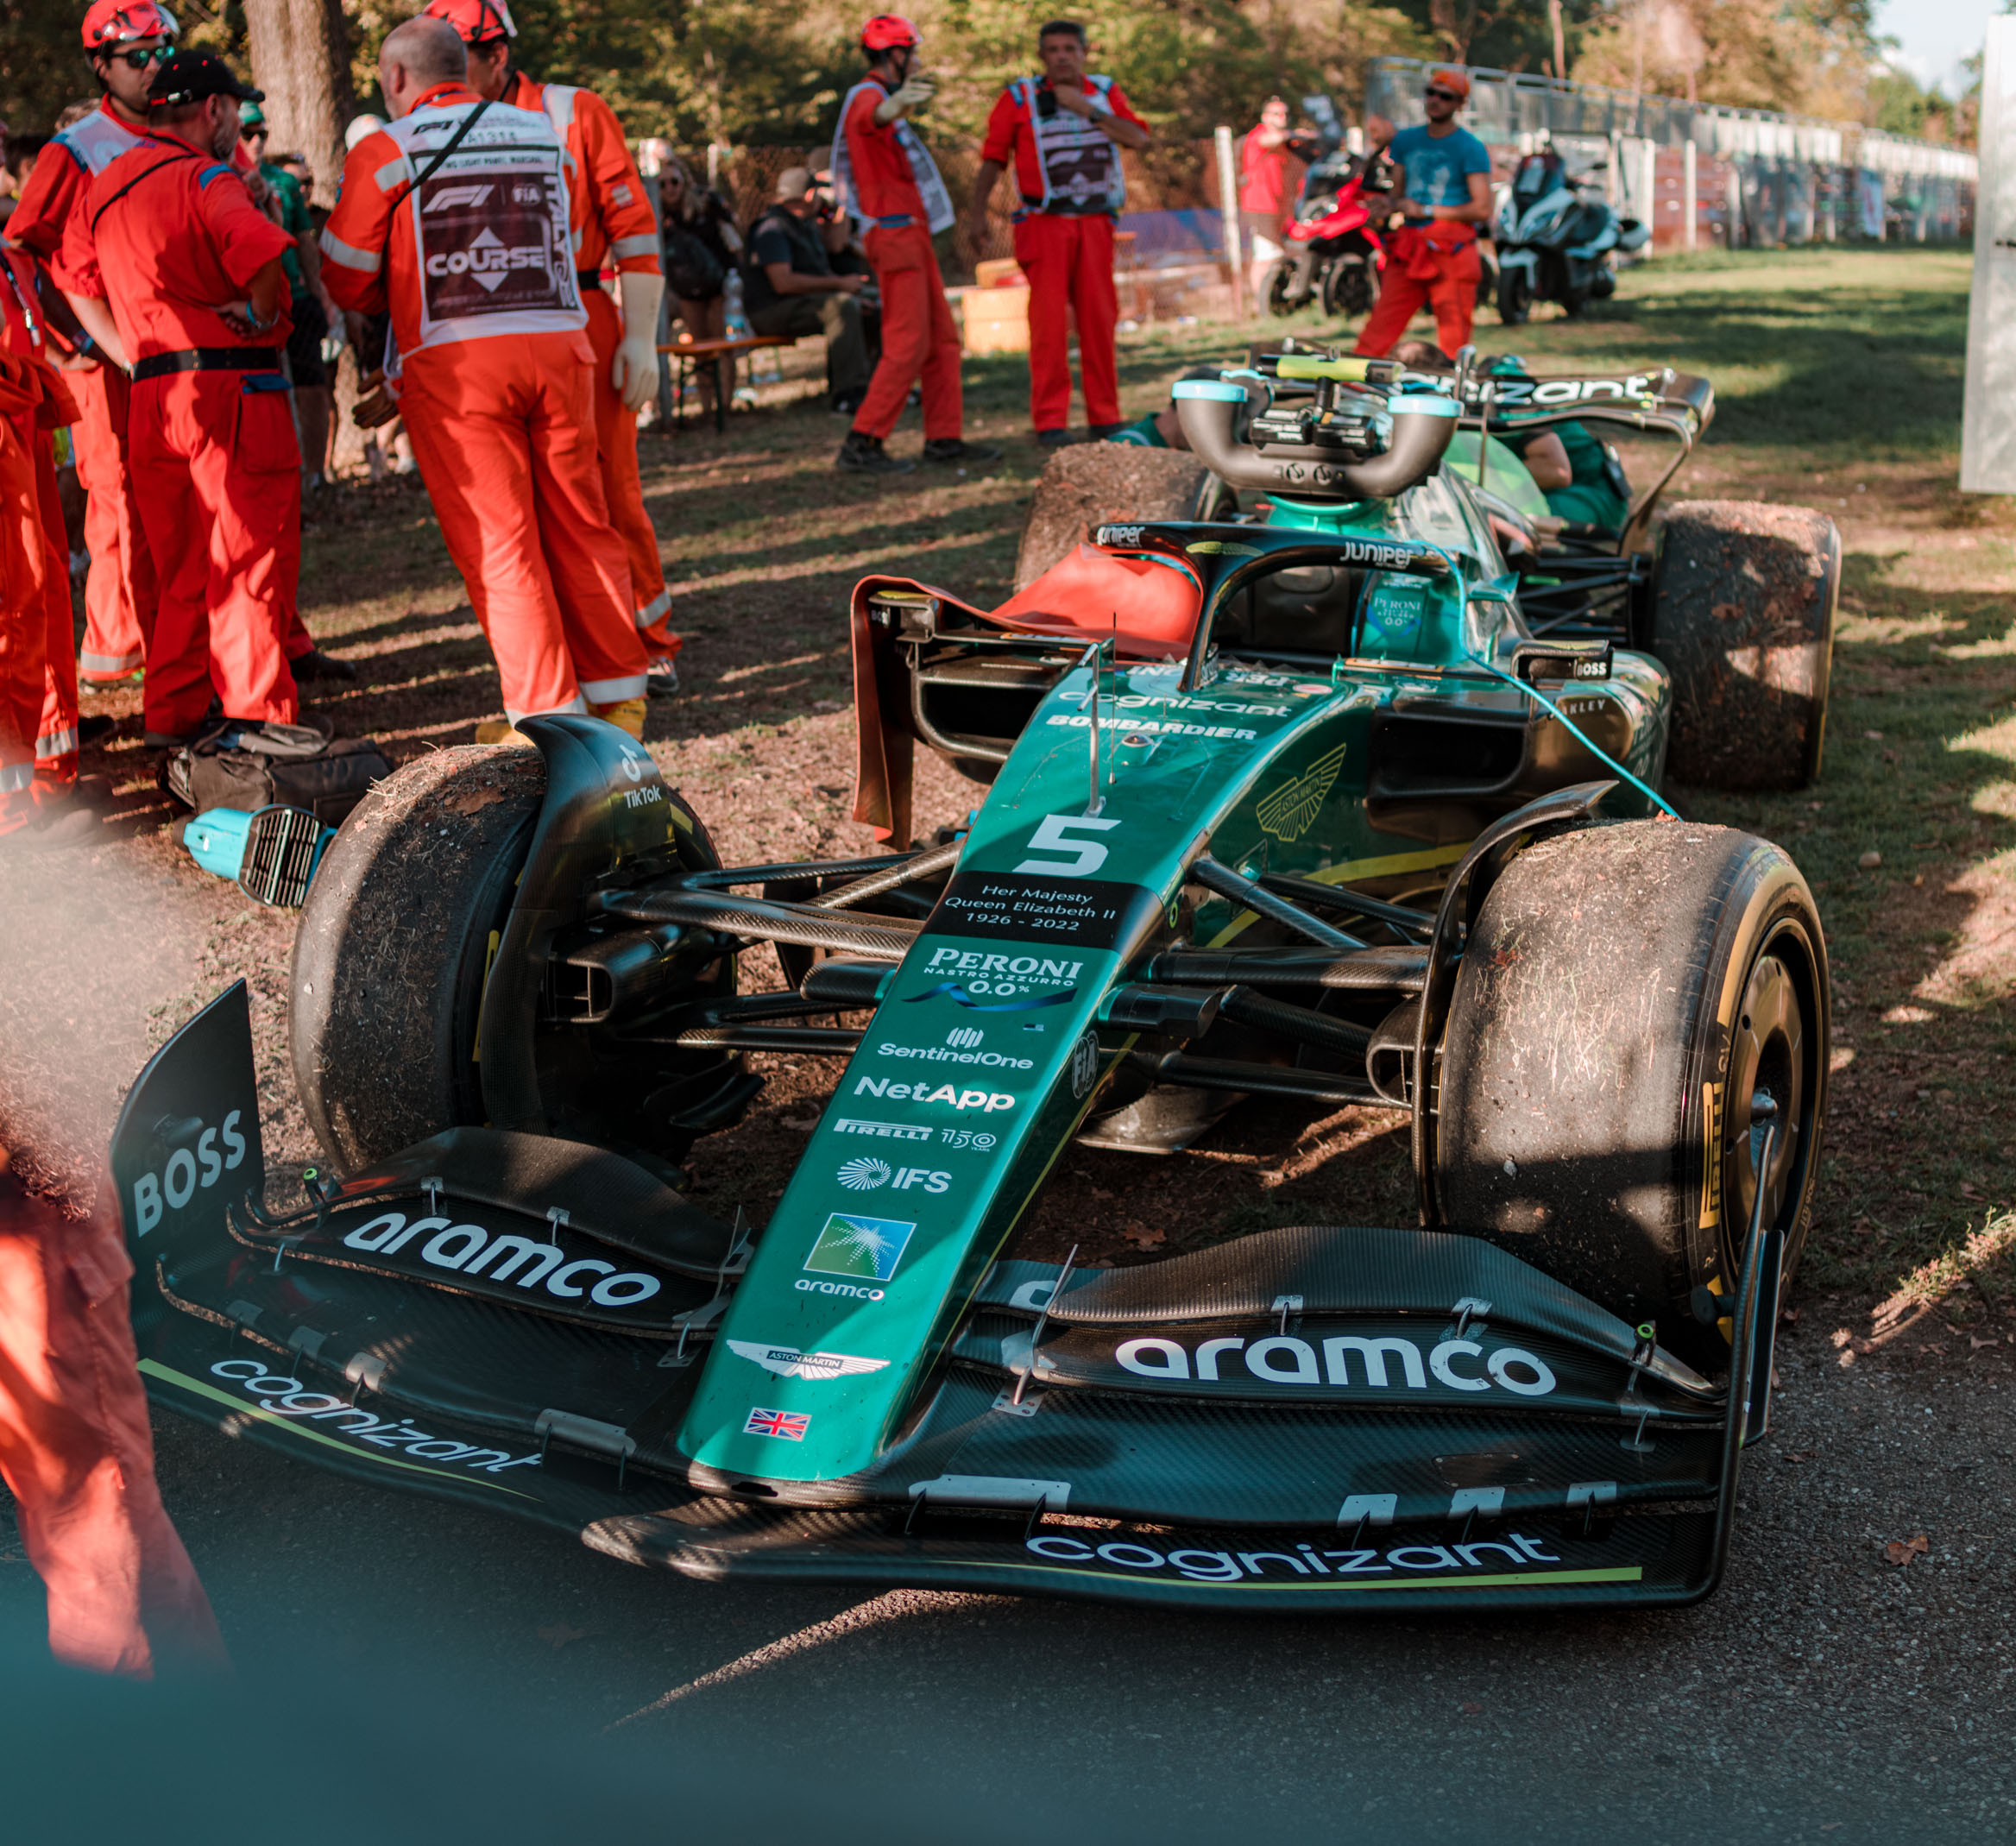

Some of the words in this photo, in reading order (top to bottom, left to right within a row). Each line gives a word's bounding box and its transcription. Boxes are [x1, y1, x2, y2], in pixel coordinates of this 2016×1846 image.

[426, 246, 546, 277] COURSE
[1059, 691, 1292, 717] cognizant
[1045, 715, 1257, 740] BOMBARDIER
[623, 784, 662, 809] TikTok
[1011, 814, 1123, 878] 5
[981, 885, 1017, 897] Her
[1022, 887, 1093, 905] Majesty
[944, 897, 1006, 910] Queen
[1013, 902, 1096, 918] Elizabeth
[1103, 909, 1116, 920] II
[966, 912, 1011, 925] 1926
[1030, 917, 1080, 931] 2022
[923, 967, 989, 979] NASTRO
[993, 973, 1075, 987] AZZURRO
[928, 948, 1084, 980] PERONI
[968, 980, 1030, 997] 0.0%
[877, 1043, 1034, 1069] SentinelOne
[854, 1075, 1016, 1113] NetApp
[833, 1118, 934, 1141] PIRELLI
[941, 1128, 997, 1149] 150
[133, 1108, 246, 1238] BOSS
[891, 1167, 953, 1194] IFS
[343, 1213, 661, 1307] aramco
[794, 1278, 885, 1301] aramco
[769, 1351, 802, 1363] ASTON
[802, 1356, 841, 1368] MARTIN
[1115, 1336, 1557, 1396] aramco
[210, 1359, 544, 1472] cognizant
[1025, 1532, 1562, 1583] cognizant
